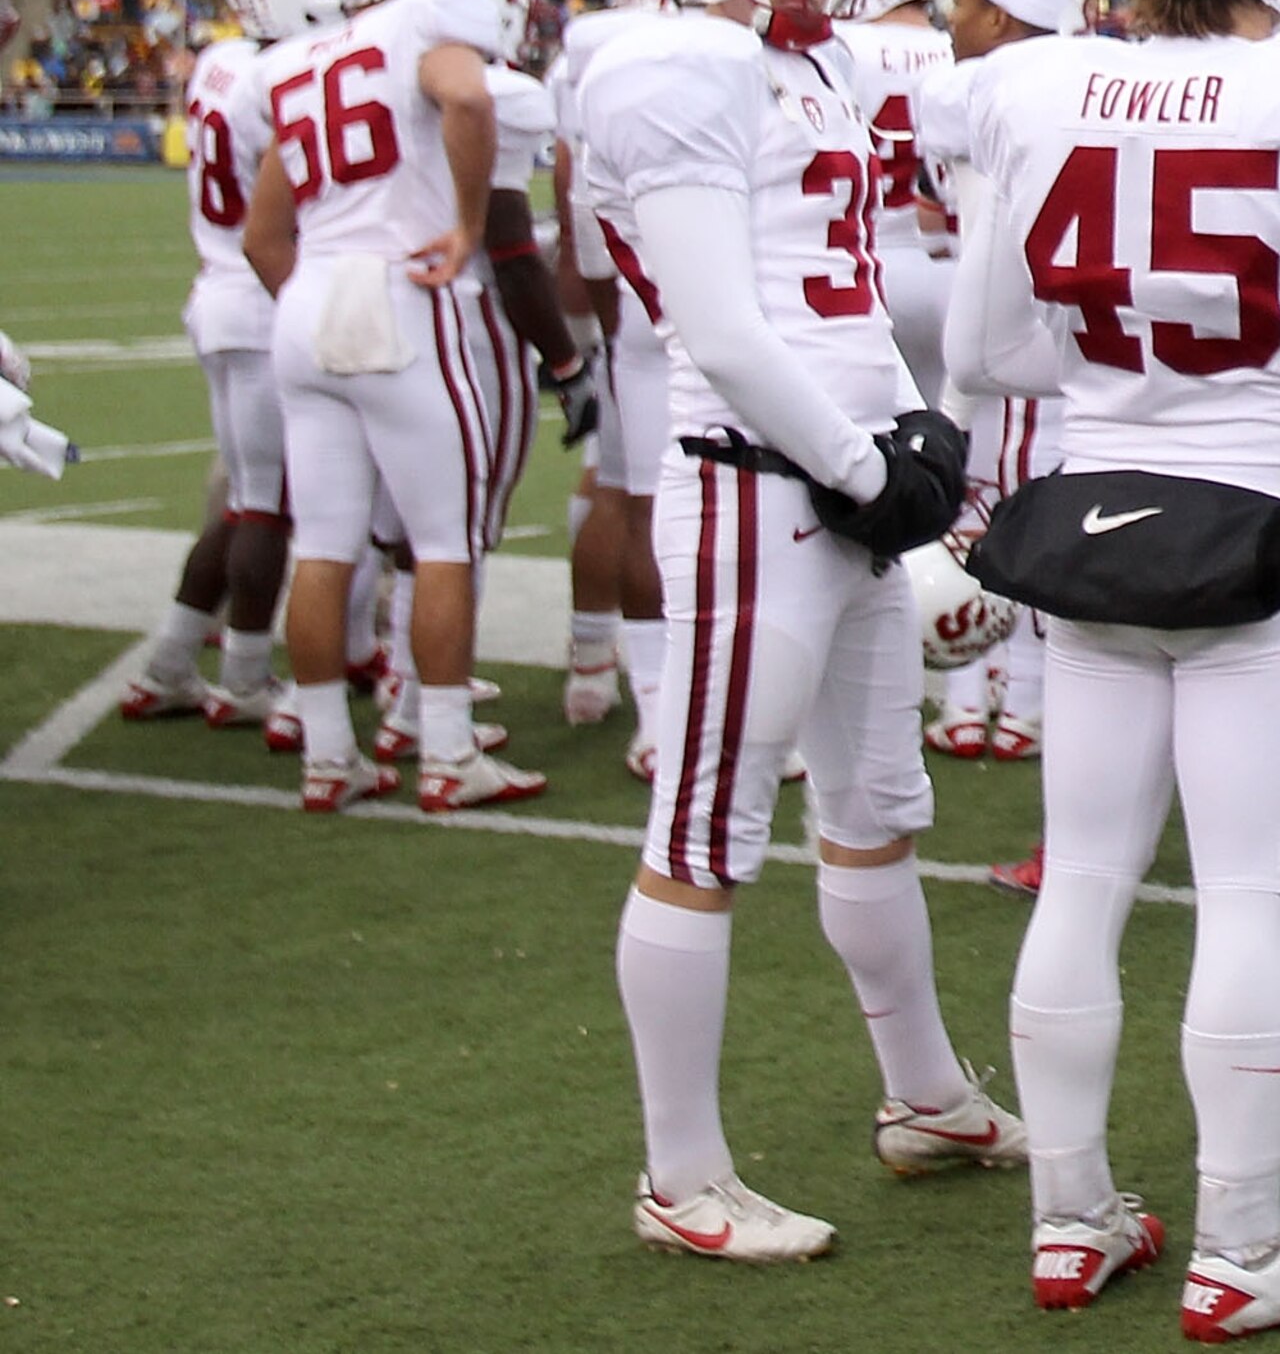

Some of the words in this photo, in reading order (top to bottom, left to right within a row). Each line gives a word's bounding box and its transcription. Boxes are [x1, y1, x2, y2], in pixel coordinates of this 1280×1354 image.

[271, 46, 400, 205] 56
[1080, 69, 1224, 124] FOWLER
[188, 98, 246, 228] 8
